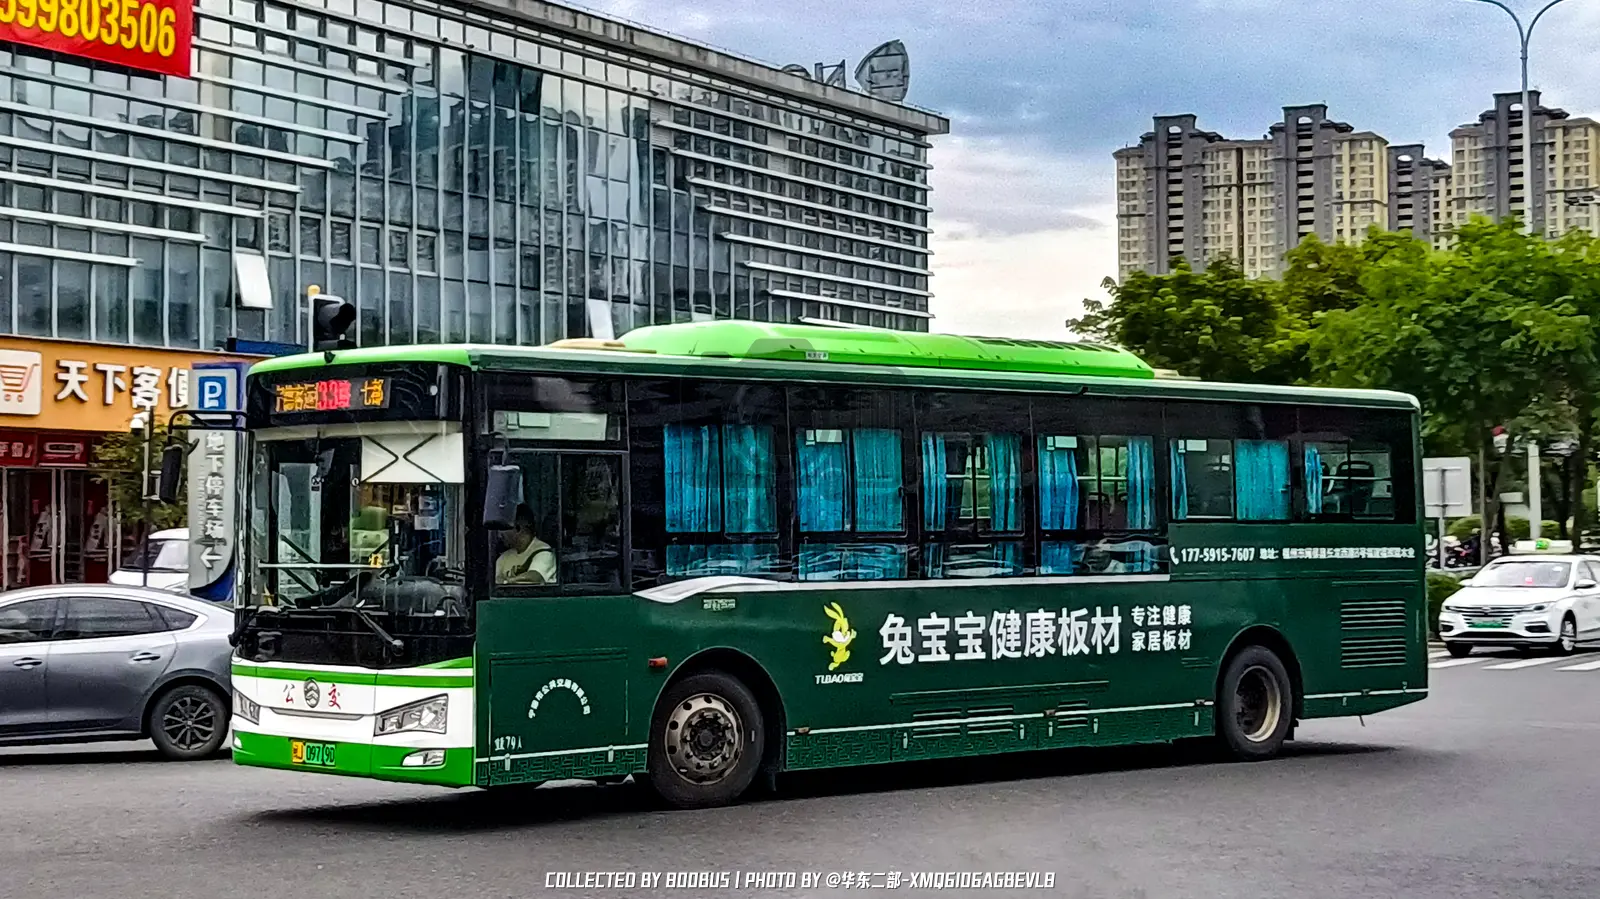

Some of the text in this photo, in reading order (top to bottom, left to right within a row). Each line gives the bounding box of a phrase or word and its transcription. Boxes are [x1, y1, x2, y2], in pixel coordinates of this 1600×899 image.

[204, 381, 222, 408] P
[1181, 547, 1255, 562] 177-5915-7607
[1131, 604, 1192, 627] 专注健康
[879, 606, 1122, 666] 兔宝宝健康板材
[1131, 628, 1193, 652] 家居板材
